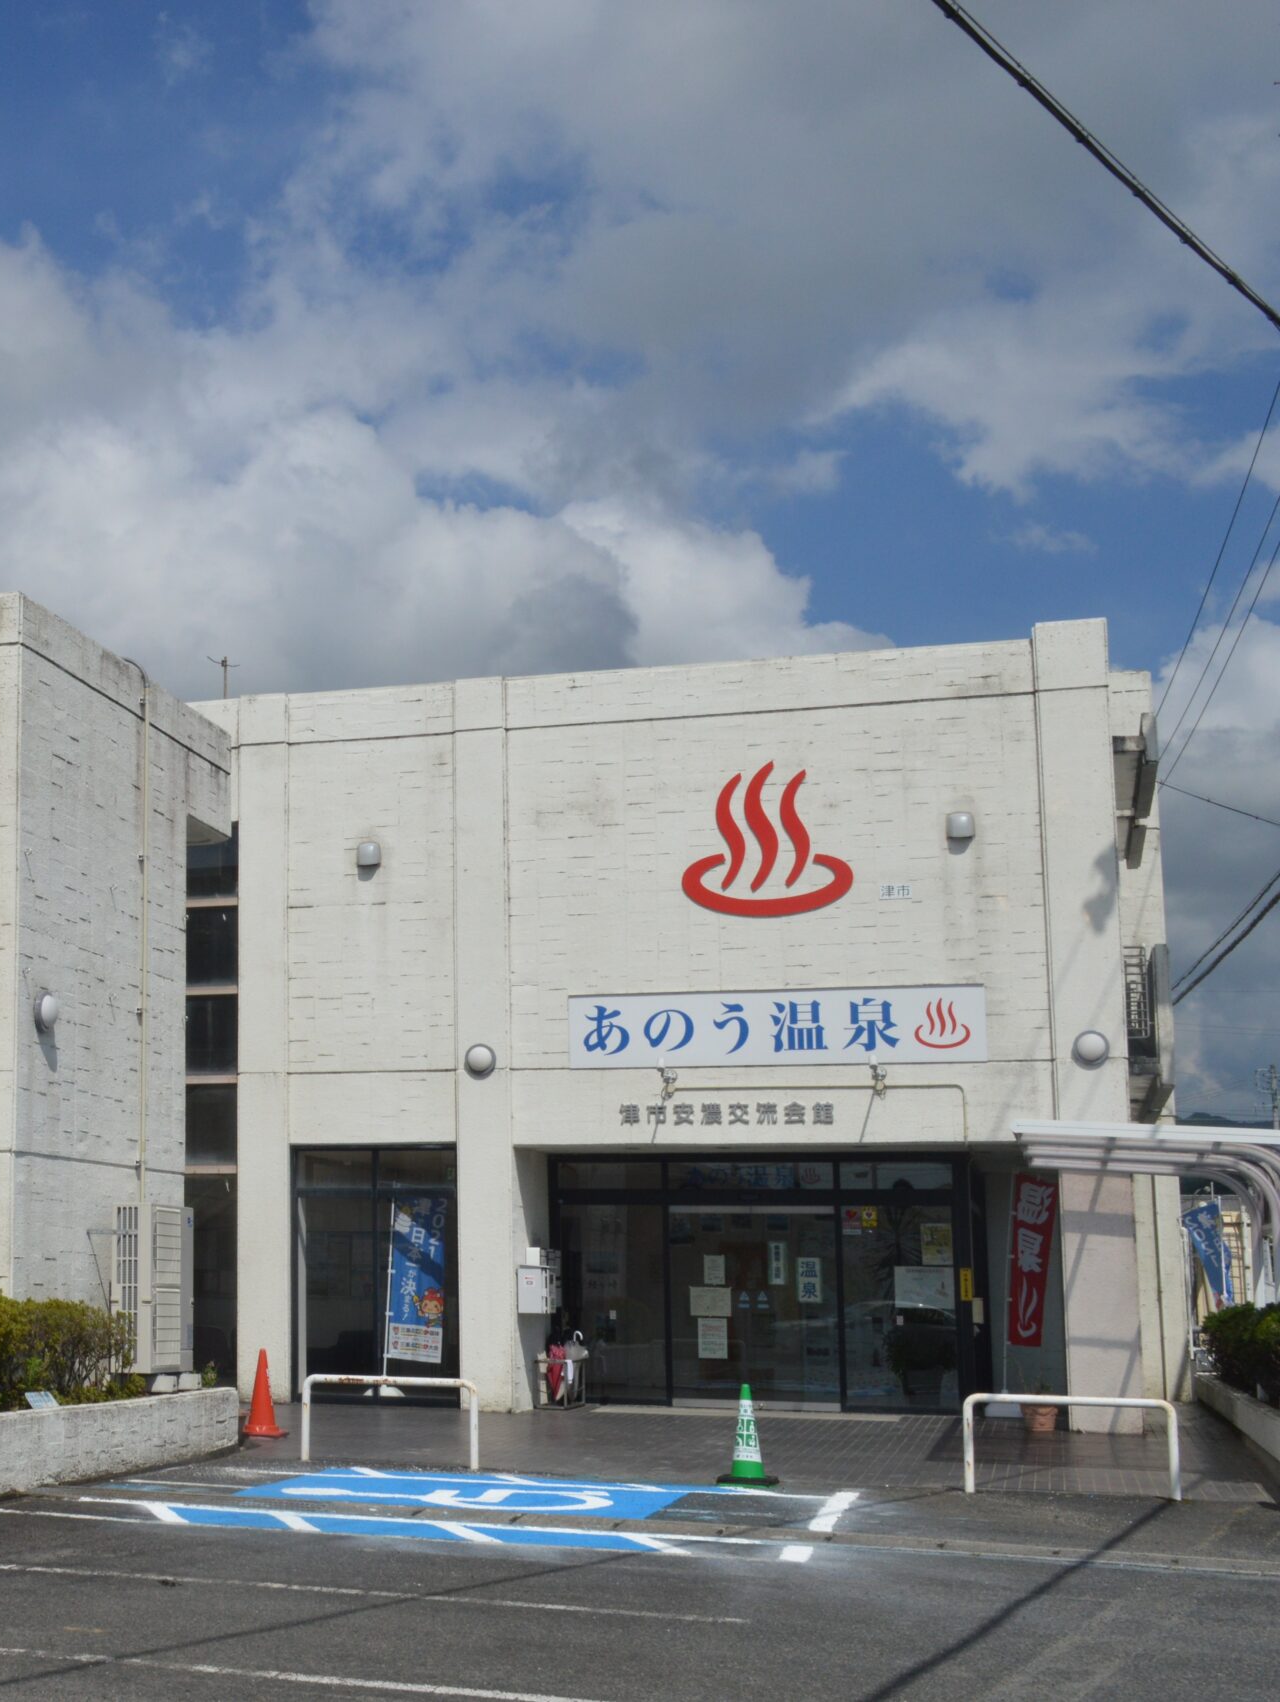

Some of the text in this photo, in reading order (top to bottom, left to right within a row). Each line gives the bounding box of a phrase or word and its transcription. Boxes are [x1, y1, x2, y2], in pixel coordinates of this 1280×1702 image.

[879, 884, 911, 899] 津市
[583, 998, 900, 1056] あのう温泉
[619, 1101, 835, 1126] 津市安濃交流会館
[800, 1261, 818, 1299] 温泉
